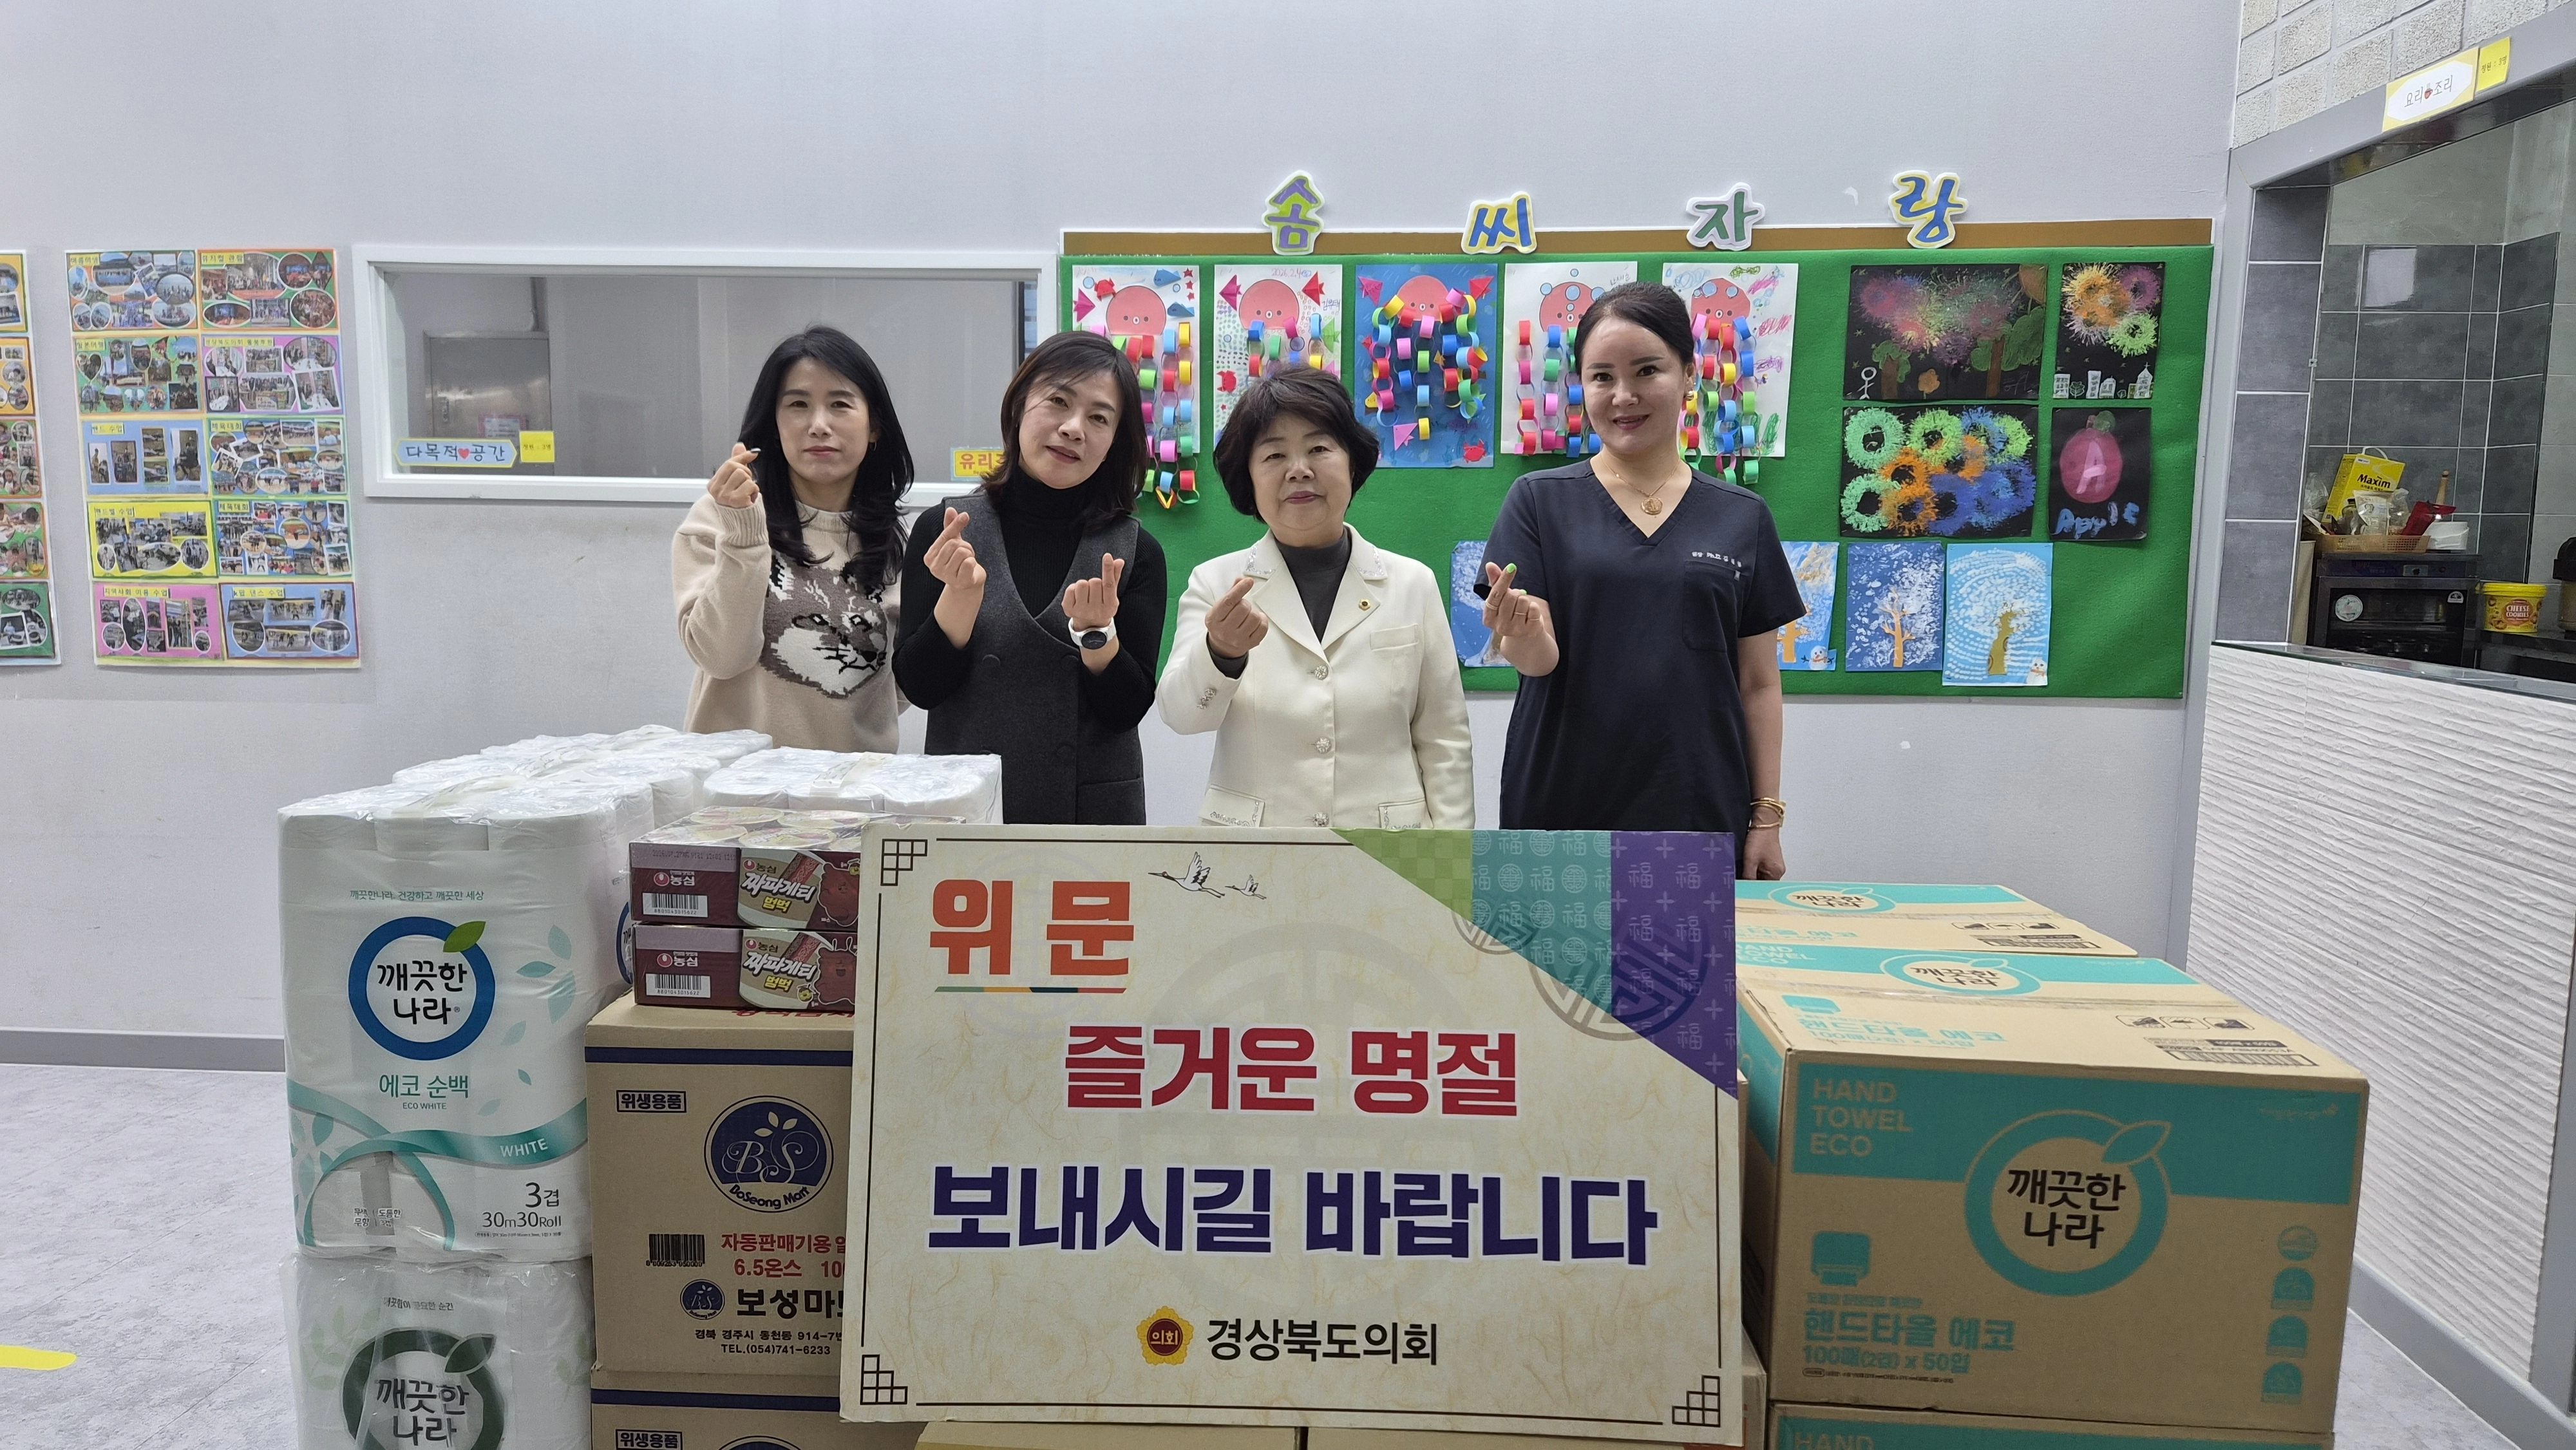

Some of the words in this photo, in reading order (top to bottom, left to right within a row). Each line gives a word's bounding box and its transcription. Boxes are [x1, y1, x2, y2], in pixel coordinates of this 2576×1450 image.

[2481, 62, 2491, 73] 정원
[2498, 55, 2507, 66] 3명
[2404, 86, 2423, 108] 요리
[2433, 75, 2453, 96] 조리
[1267, 179, 1320, 249] 솜
[1468, 198, 1532, 247] 씨
[1695, 191, 1758, 242] 자
[1895, 176, 1963, 243] 랑
[406, 443, 458, 461] 다목적
[470, 444, 506, 462] 공간
[2357, 474, 2391, 489] Maxim
[757, 863, 777, 874] 농심
[670, 875, 695, 886] 농심
[742, 872, 816, 903] 짜파게티
[398, 890, 433, 901] 건강하고
[436, 890, 463, 901] 깨끗한
[466, 891, 484, 901] 세상
[762, 896, 791, 912] 범벅
[930, 879, 1013, 975] 위
[1046, 881, 1133, 975] 문
[758, 942, 778, 953] 농심
[674, 956, 698, 966] 농심
[743, 952, 817, 980] 짜파게티
[377, 960, 468, 992] 깨끗한
[1911, 965, 2000, 980] 깨끗한
[1937, 975, 2000, 988] 나라
[765, 975, 793, 991] 범벅
[393, 997, 451, 1025] 나라
[1065, 1026, 1317, 1111] 즐거운
[1352, 1031, 1517, 1116] 명절
[379, 1074, 421, 1098] 에코
[426, 1074, 469, 1098] 순백
[1814, 1078, 1897, 1103] HAND
[620, 1093, 682, 1110] 위생용품
[1812, 1105, 1912, 1132] TOWEL
[500, 1138, 549, 1158] WHITE
[1810, 1133, 1872, 1157] ECO
[526, 1182, 559, 1207] 3겹
[2007, 1169, 2126, 1211] 깨끗한
[929, 1166, 1271, 1253] 보내시길
[1306, 1171, 1658, 1266] 바랍니다
[2024, 1211, 2105, 1249] 나라
[721, 1234, 832, 1253] 자동판매기용
[734, 1258, 802, 1277] 6.5온스
[821, 1261, 846, 1277] 10
[439, 1302, 454, 1311] 순간
[696, 1330, 716, 1340] 경북
[722, 1330, 754, 1341] 경주시
[760, 1330, 792, 1341] 동천동
[1150, 1329, 1179, 1346] 의회
[1804, 1308, 1937, 1348] 핸드타올
[1949, 1317, 2015, 1351] 에코
[721, 1344, 831, 1355] TEL.(054)741-6233
[1208, 1318, 1437, 1365] 경상북도의회
[376, 1378, 469, 1415] 깨끗한
[393, 1416, 457, 1447] 나라
[620, 1433, 678, 1448] 위생용품
[1794, 1432, 1875, 1450] HAND
